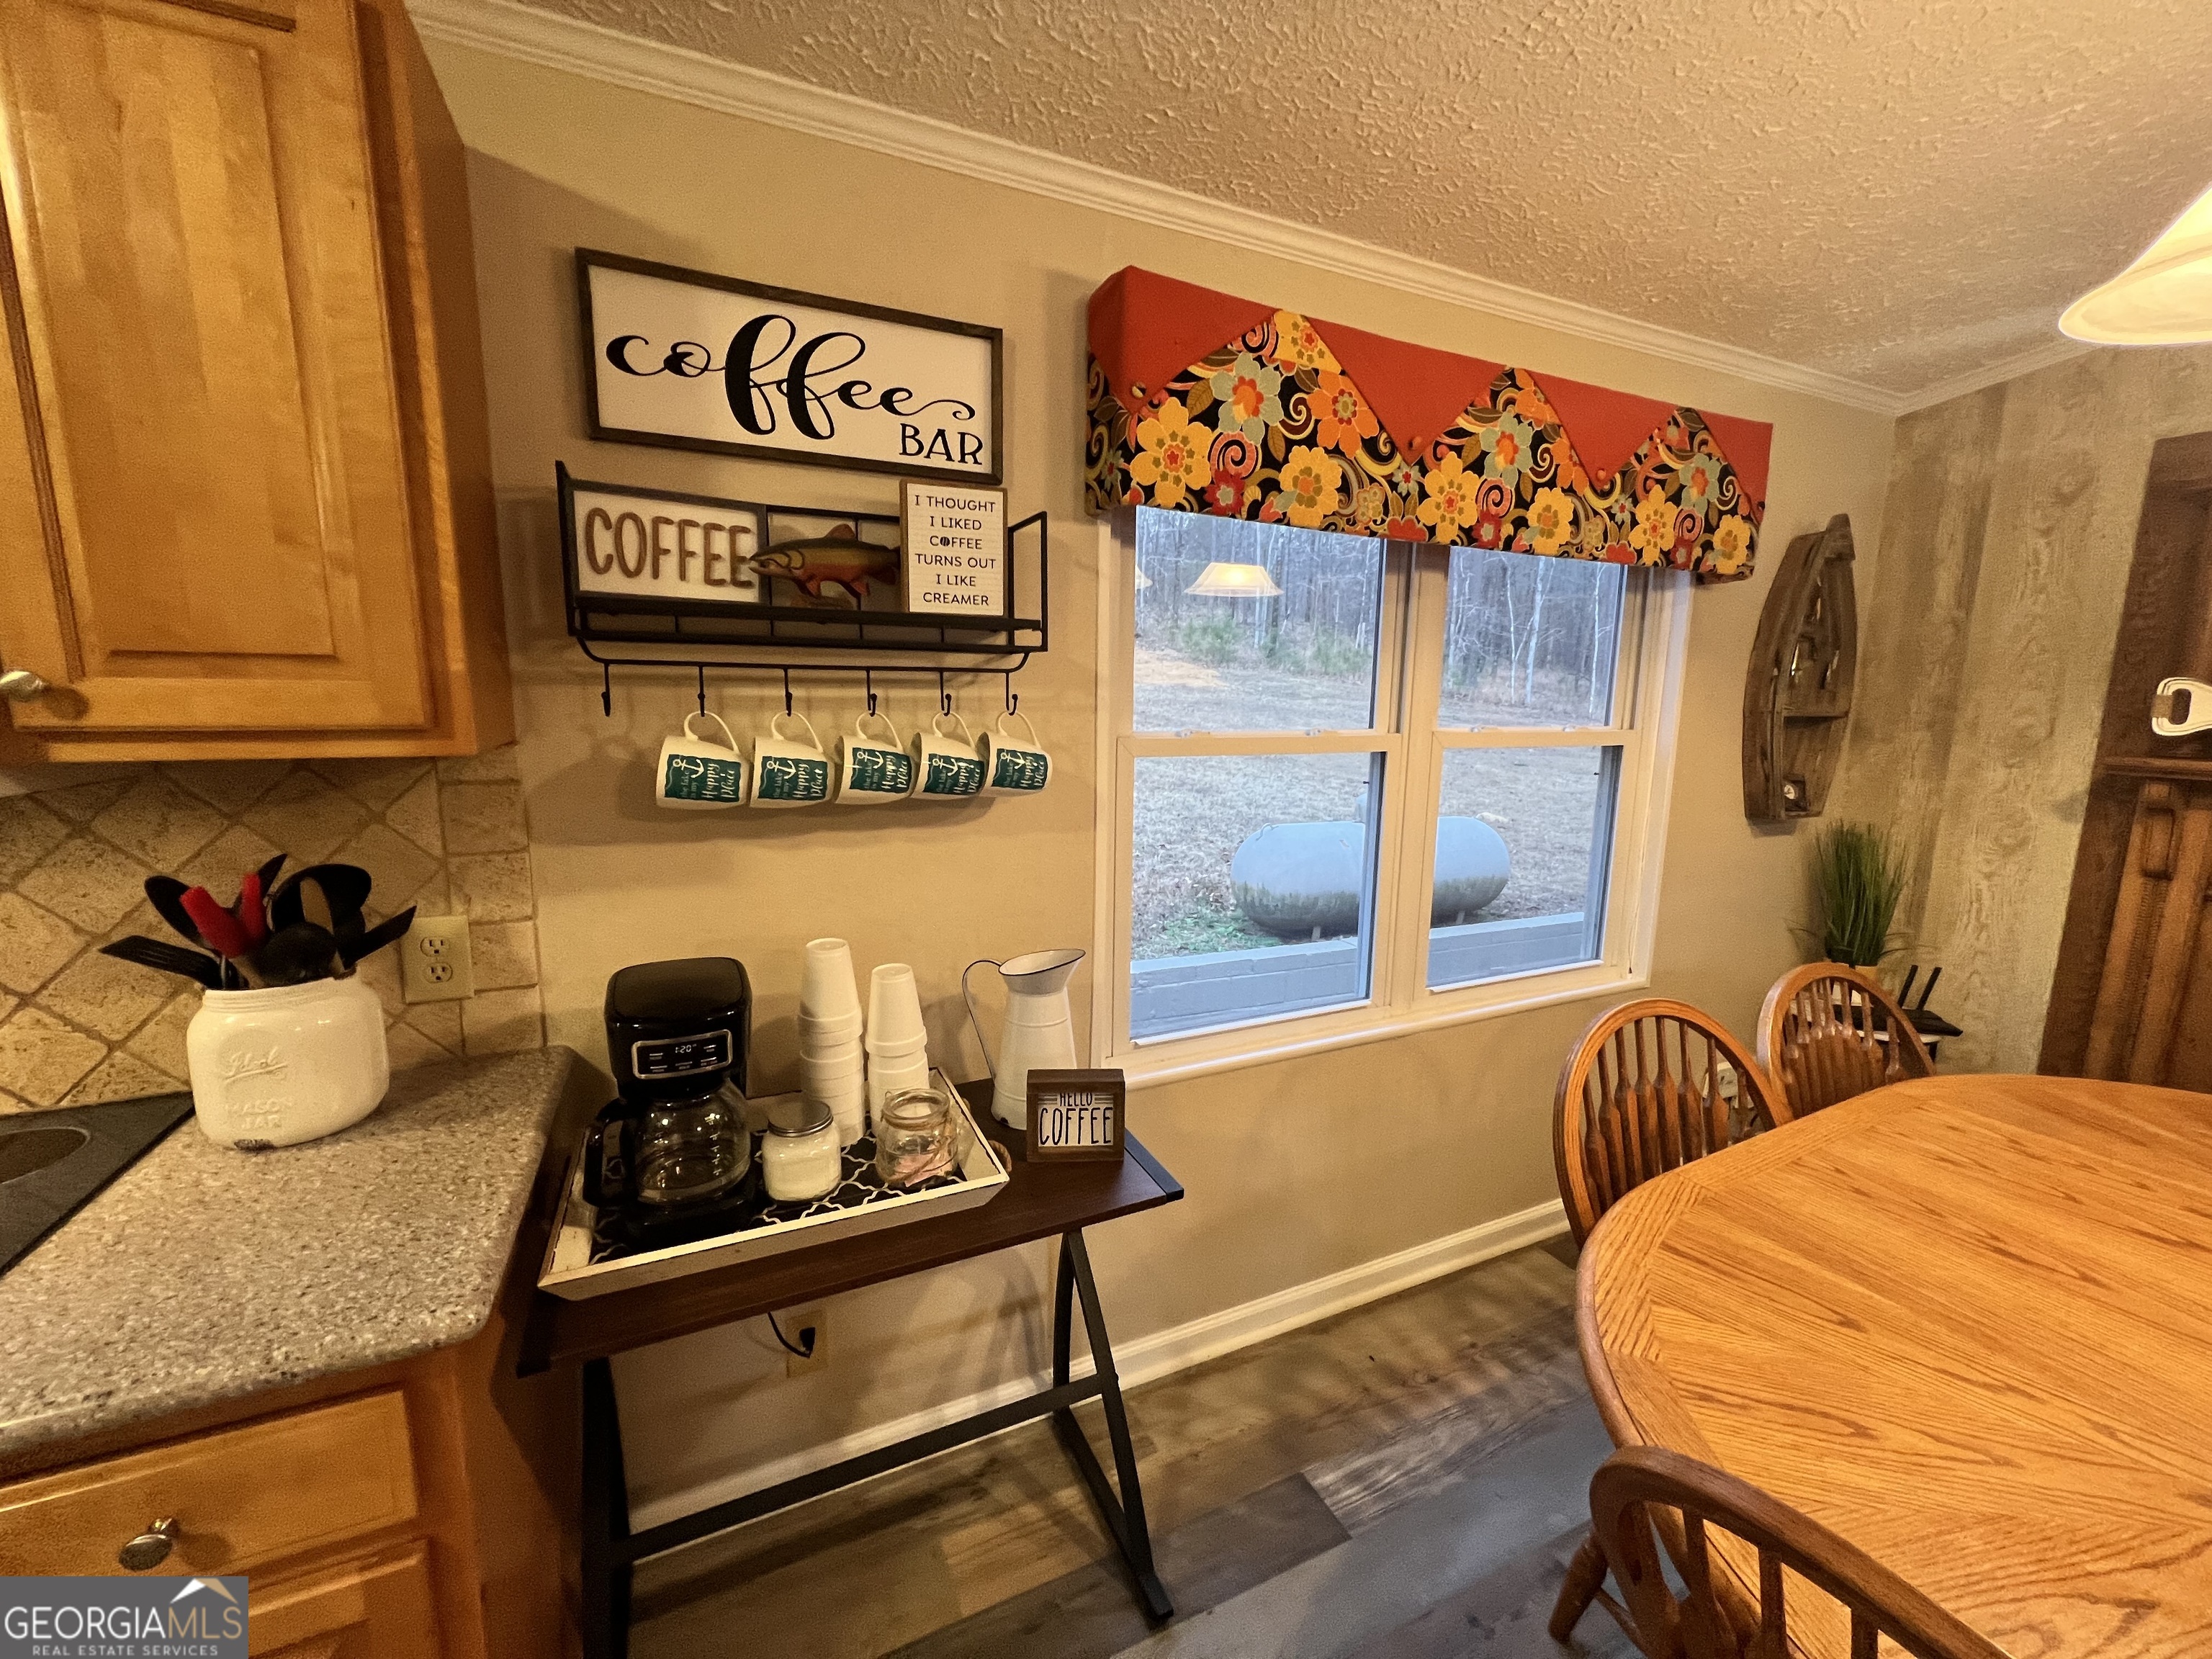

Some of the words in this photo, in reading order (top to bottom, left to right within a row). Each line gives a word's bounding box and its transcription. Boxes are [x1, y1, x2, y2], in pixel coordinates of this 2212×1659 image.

[606, 314, 976, 440] coffee
[899, 423, 984, 466] BAR
[914, 495, 920, 506] I
[927, 496, 996, 513] THOUGHT
[930, 516, 935, 527] I
[941, 517, 982, 531] LIKED
[585, 507, 754, 587] COFFEE
[930, 535, 982, 549] COFFEE
[915, 553, 962, 567] TURNS
[968, 557, 997, 570] OUT
[936, 574, 941, 585] I
[947, 575, 976, 587] LIKE
[923, 592, 989, 606] CREAMER
[701, 763, 720, 799] Happy
[792, 764, 810, 798] Happy
[881, 755, 897, 789] Happy
[1060, 1092, 1093, 1107] HELLO
[1040, 1107, 1113, 1145] COFFEE
